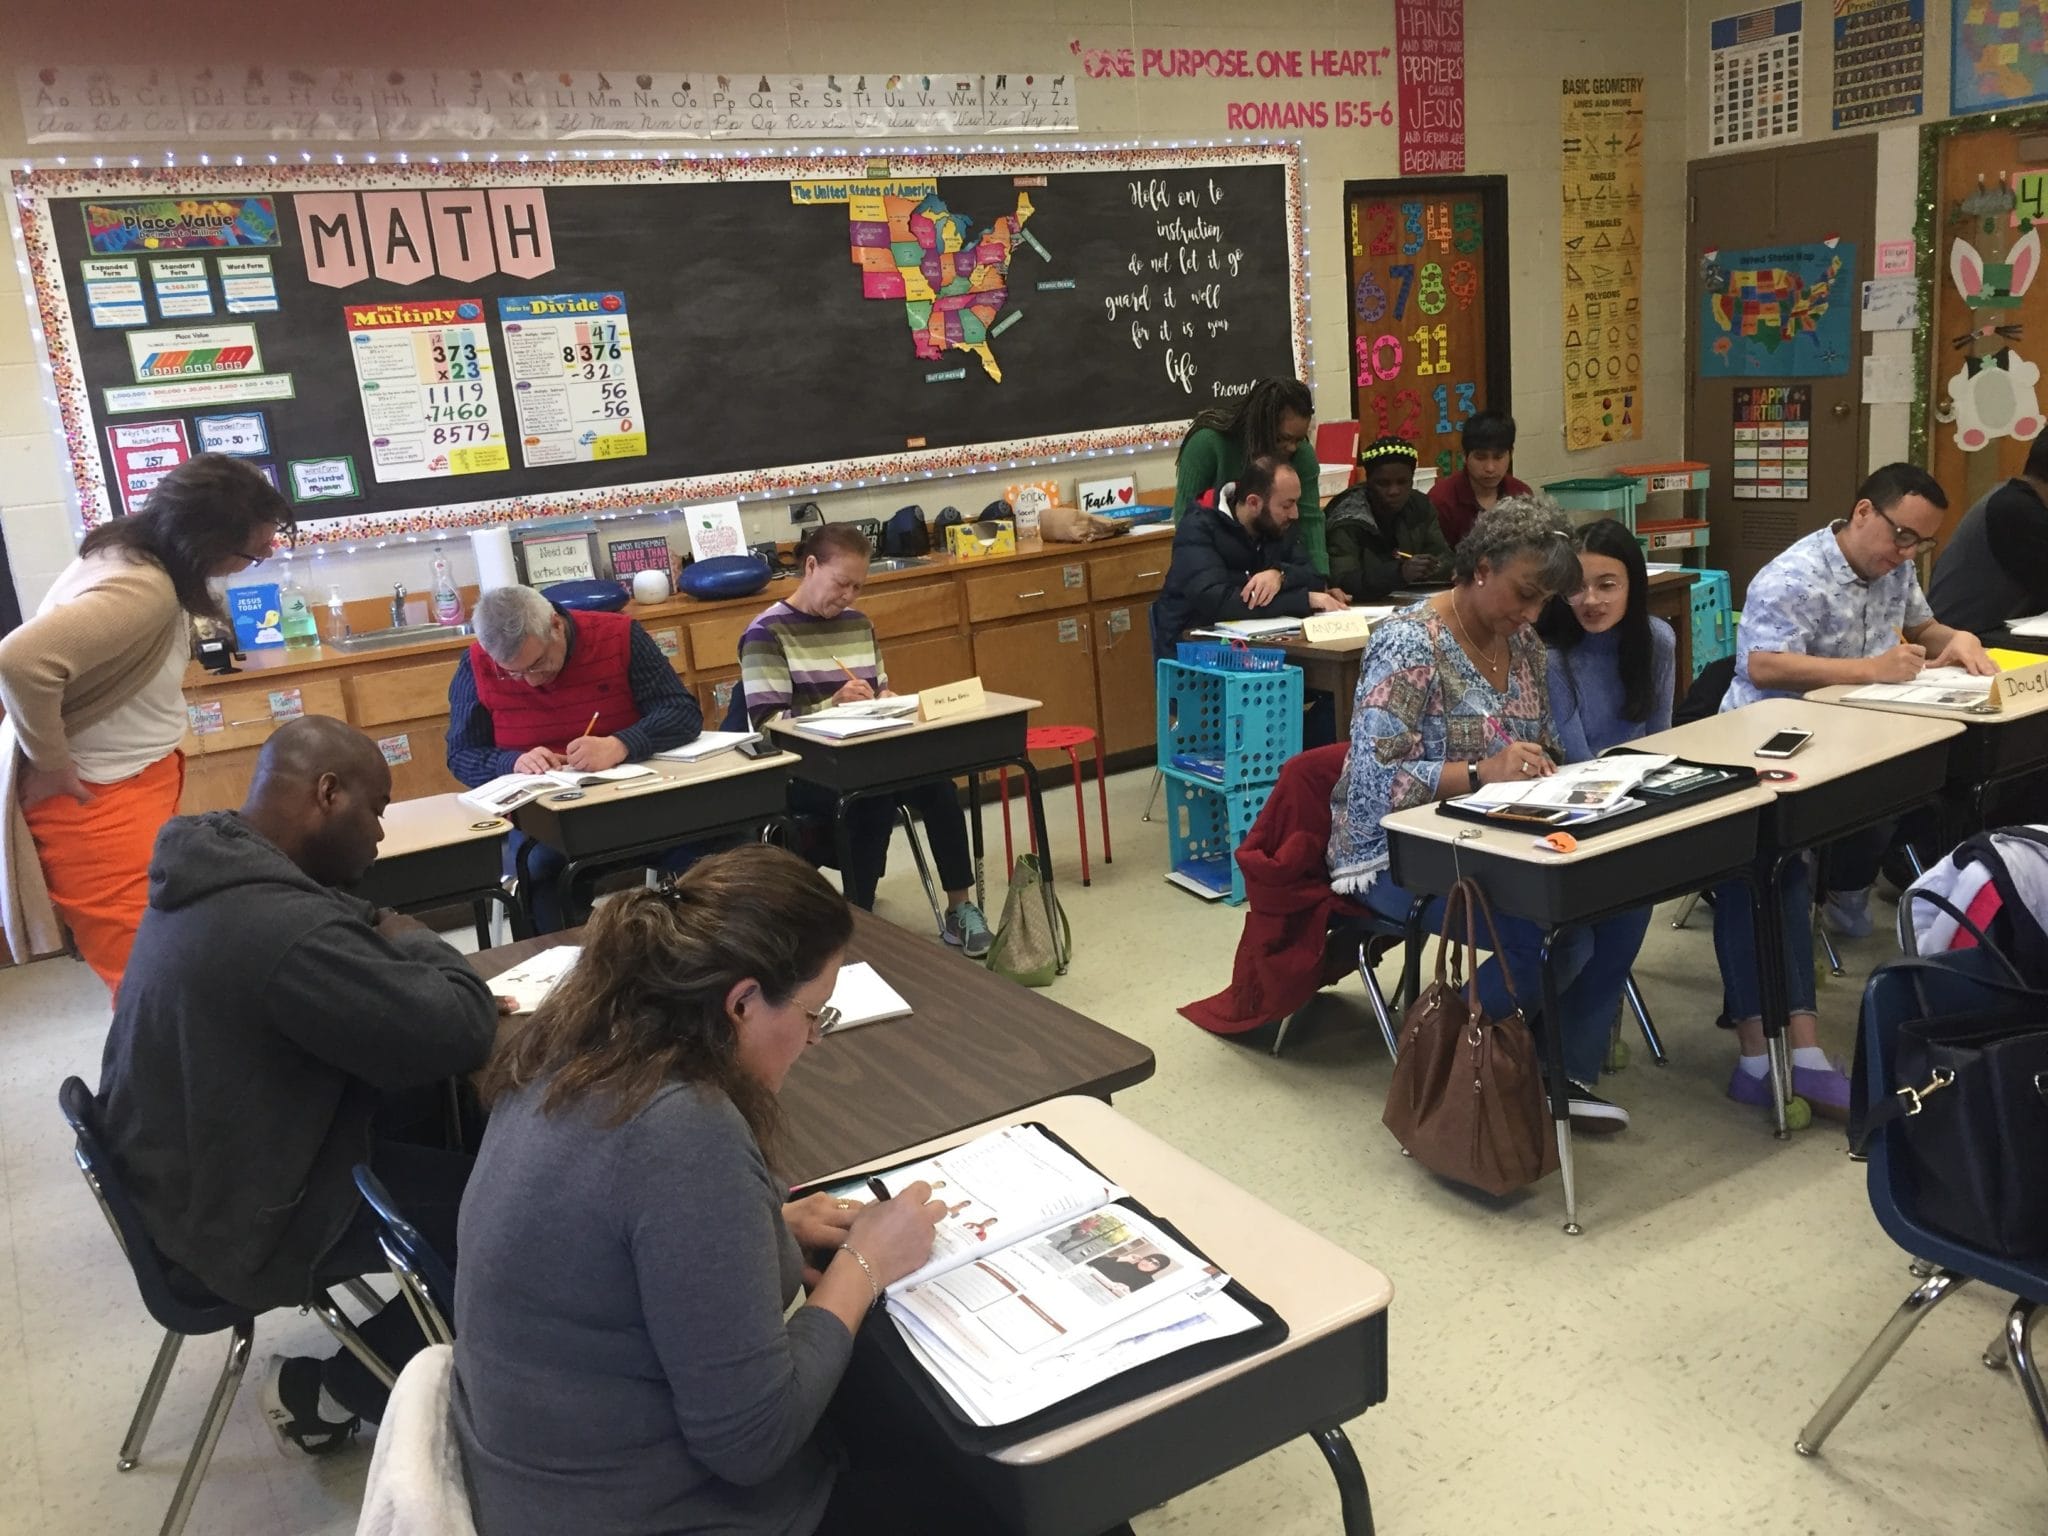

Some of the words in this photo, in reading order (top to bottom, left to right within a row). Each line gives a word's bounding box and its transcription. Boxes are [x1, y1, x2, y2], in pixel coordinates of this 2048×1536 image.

[1401, 7, 1461, 37] HANDS
[1401, 39, 1419, 52] AND
[1142, 48, 1253, 78] PURPOSE.
[1256, 50, 1303, 78] ONE
[1402, 55, 1463, 86] PRAYERS
[1562, 79, 1590, 95] BASIC
[1593, 77, 1644, 95] GEOMETRY
[1227, 101, 1328, 129] ROMANS
[1335, 100, 1394, 128] 15:5-6
[1409, 87, 1463, 129] JESUS
[1404, 131, 1421, 144] AND
[1404, 149, 1465, 172] EVERYWHERE
[1589, 172, 1616, 182] ANGLES
[793, 186, 811, 199] The
[814, 184, 847, 199] United
[850, 184, 881, 197] States
[883, 184, 894, 196] of
[898, 183, 936, 198] America
[1128, 179, 1170, 211] Hold
[1178, 189, 1200, 208] on
[1208, 178, 1224, 205] to
[124, 215, 176, 230] Place
[180, 214, 234, 228] Value
[1156, 216, 1223, 244] instruction
[1367, 202, 1398, 256] 2
[1402, 201, 1424, 256] 3
[1427, 201, 1452, 255] 4
[1455, 201, 1483, 254] 5
[139, 229, 178, 240] Decimals
[179, 229, 190, 239] to
[191, 229, 223, 238] Millions
[309, 204, 541, 268] MATH
[91, 263, 129, 272] Expanded
[160, 262, 196, 271] Standard
[247, 262, 265, 270] Form
[1128, 252, 1144, 276] do
[1150, 252, 1172, 273] not
[1179, 246, 1200, 275] let
[1207, 248, 1221, 270] it
[1228, 248, 1245, 277] go
[1356, 270, 1386, 322] 6
[1389, 263, 1415, 321] 7
[1418, 262, 1446, 315] 8
[1450, 260, 1478, 311] 9
[530, 298, 599, 315] Divide
[1105, 284, 1150, 322] guard
[1163, 286, 1176, 308] it
[1191, 284, 1221, 309] well
[353, 308, 456, 327] Multiply
[1131, 320, 1150, 350] for
[1159, 320, 1172, 341] it
[1182, 321, 1195, 338] is
[433, 344, 478, 363] 373
[580, 343, 622, 363] 376
[1356, 335, 1403, 387] 10
[1410, 323, 1451, 376] 11
[452, 362, 481, 380] 23
[1165, 348, 1198, 394] life
[429, 383, 483, 404] 1119
[602, 382, 627, 400] 56
[1752, 387, 1791, 405] HAPPY
[433, 422, 490, 445] 8579
[621, 419, 633, 433] 0
[207, 437, 223, 447] 200
[232, 435, 244, 445] 50
[252, 434, 259, 442] 7
[144, 456, 163, 467] 257
[130, 479, 147, 490] 200
[1083, 488, 1117, 511] Teach
[616, 549, 645, 562] BRAVER
[648, 546, 667, 558] THAN
[615, 560, 632, 573] YOU
[634, 557, 669, 571] BELIEVE
[237, 598, 261, 606] JESUS
